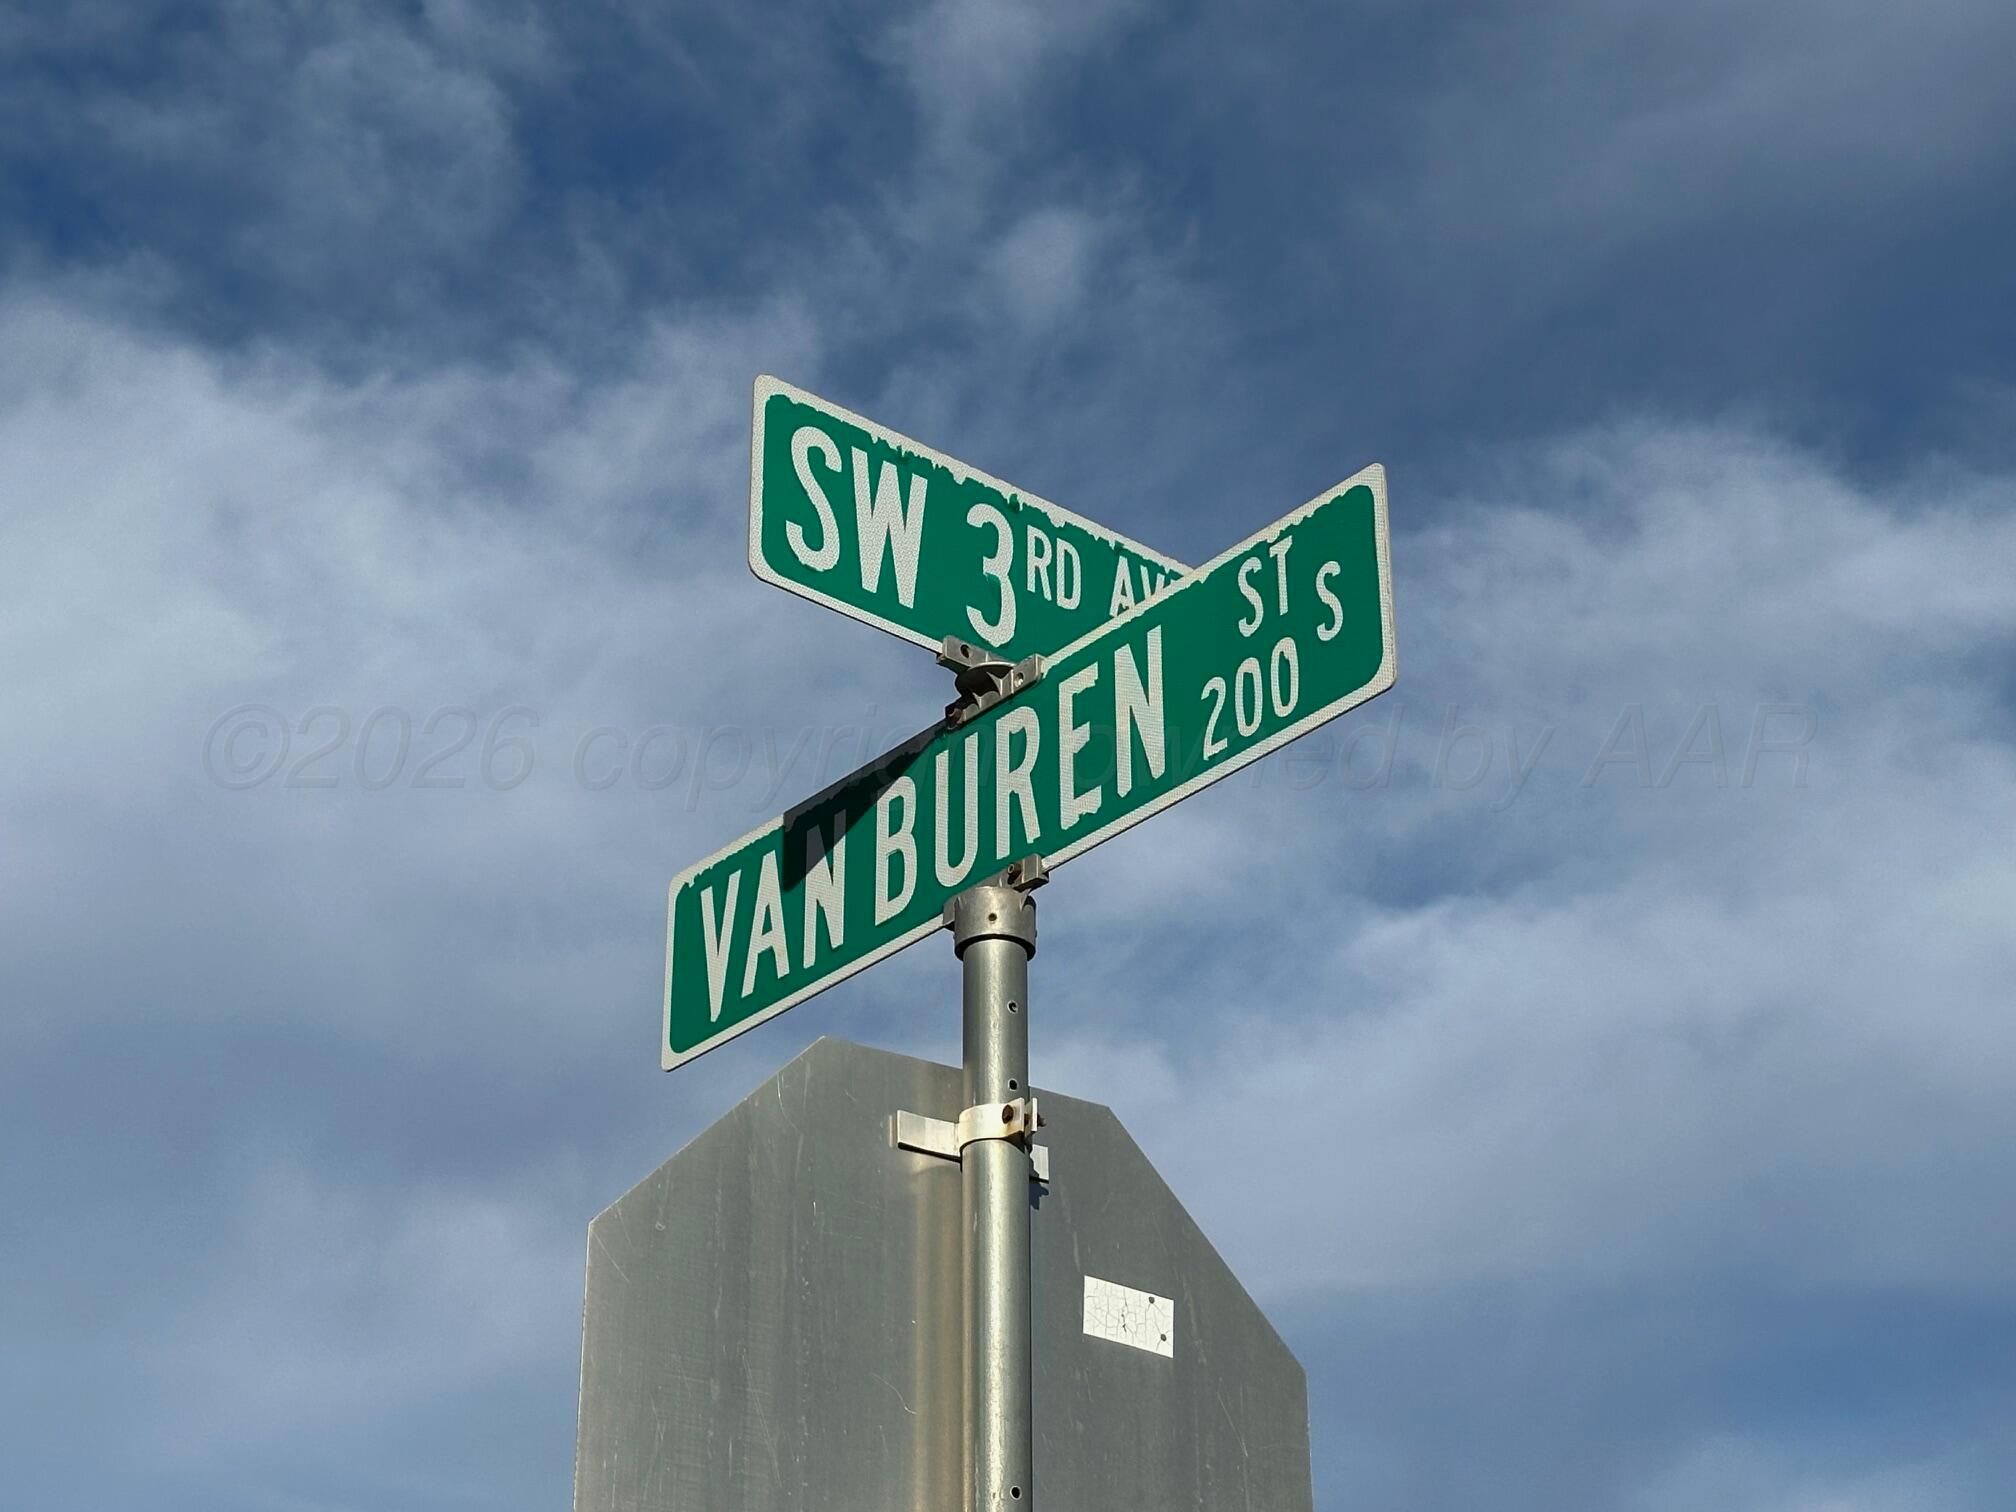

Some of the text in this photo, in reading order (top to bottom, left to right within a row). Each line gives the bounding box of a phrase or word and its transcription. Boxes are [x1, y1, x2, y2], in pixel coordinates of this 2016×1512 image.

[785, 425, 1181, 648] SW 3RD AV
[1201, 560, 1344, 761] 200 S
[700, 535, 1293, 1023] VAN BUREN ST
